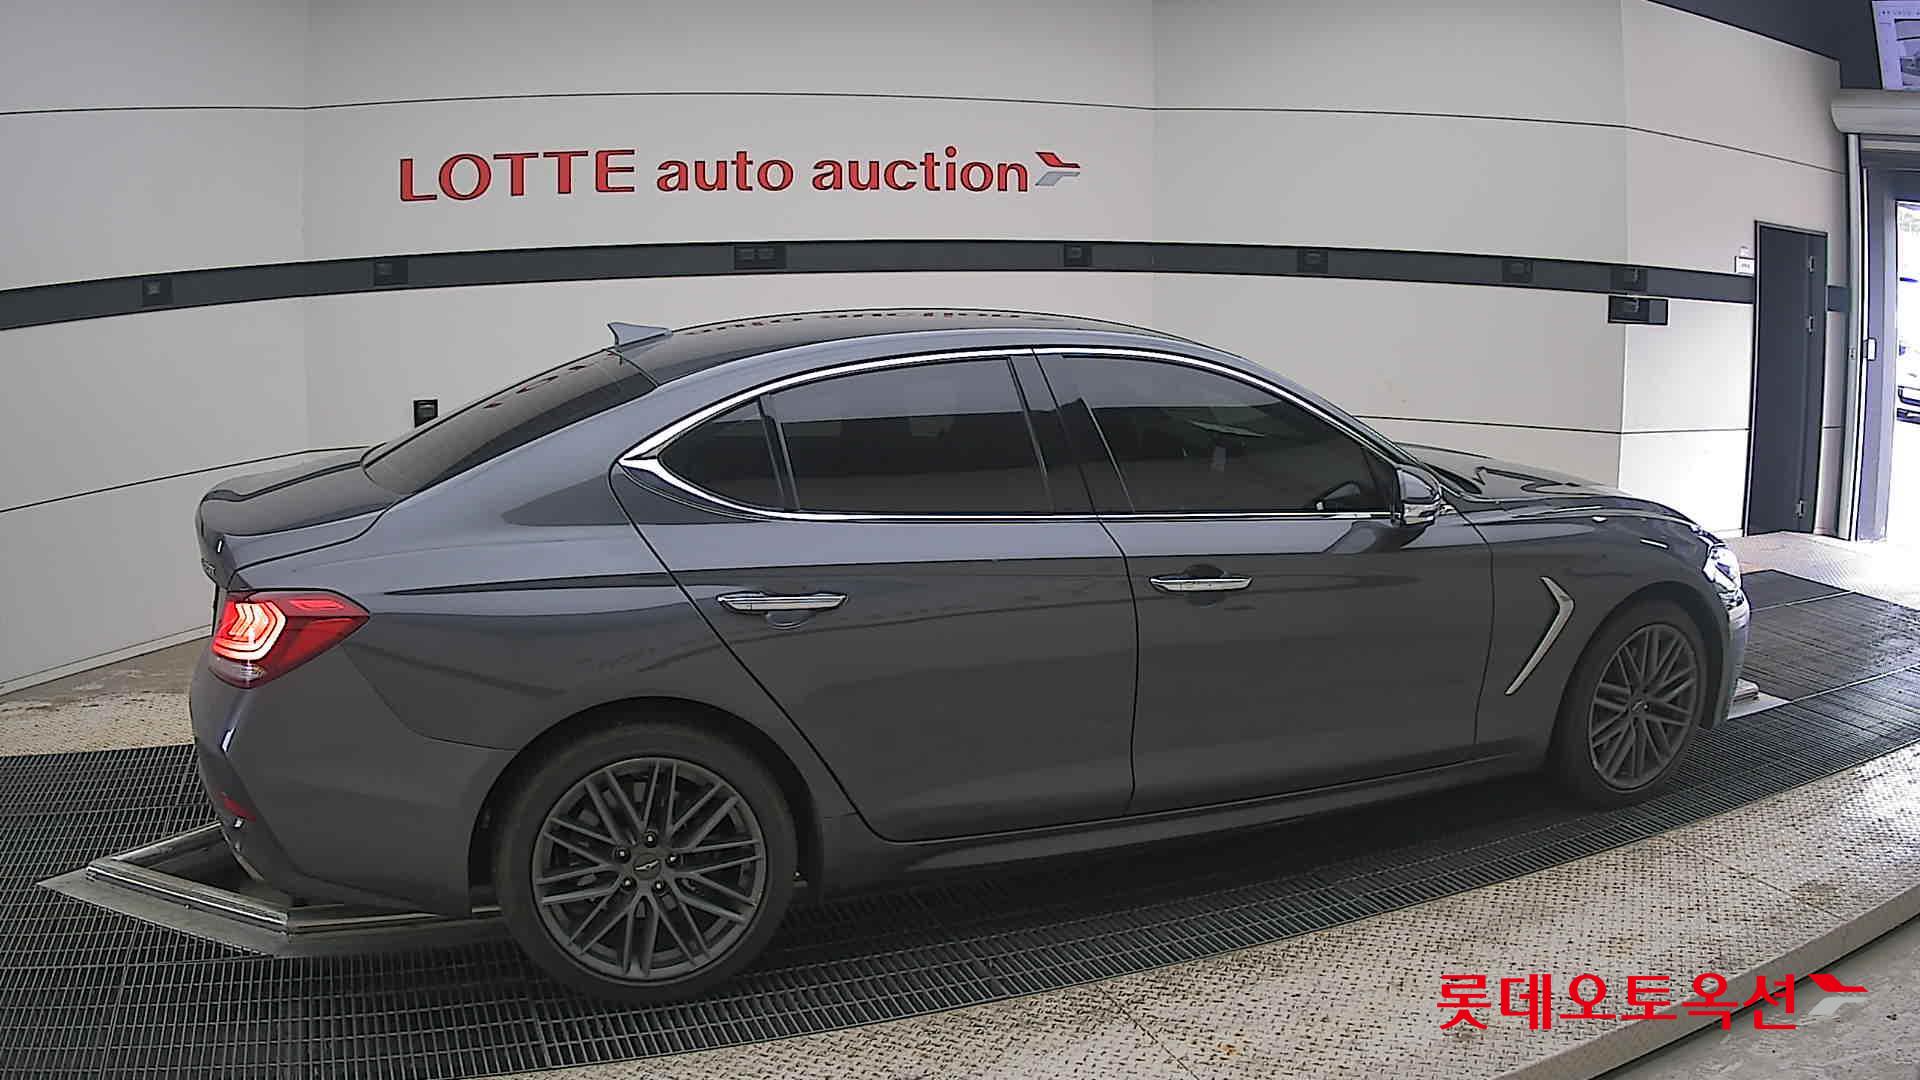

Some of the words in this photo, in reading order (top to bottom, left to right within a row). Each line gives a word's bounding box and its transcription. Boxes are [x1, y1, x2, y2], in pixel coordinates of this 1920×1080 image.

[400, 149, 636, 202] LOTTE
[656, 150, 795, 192] auto
[812, 145, 1030, 193] auction
